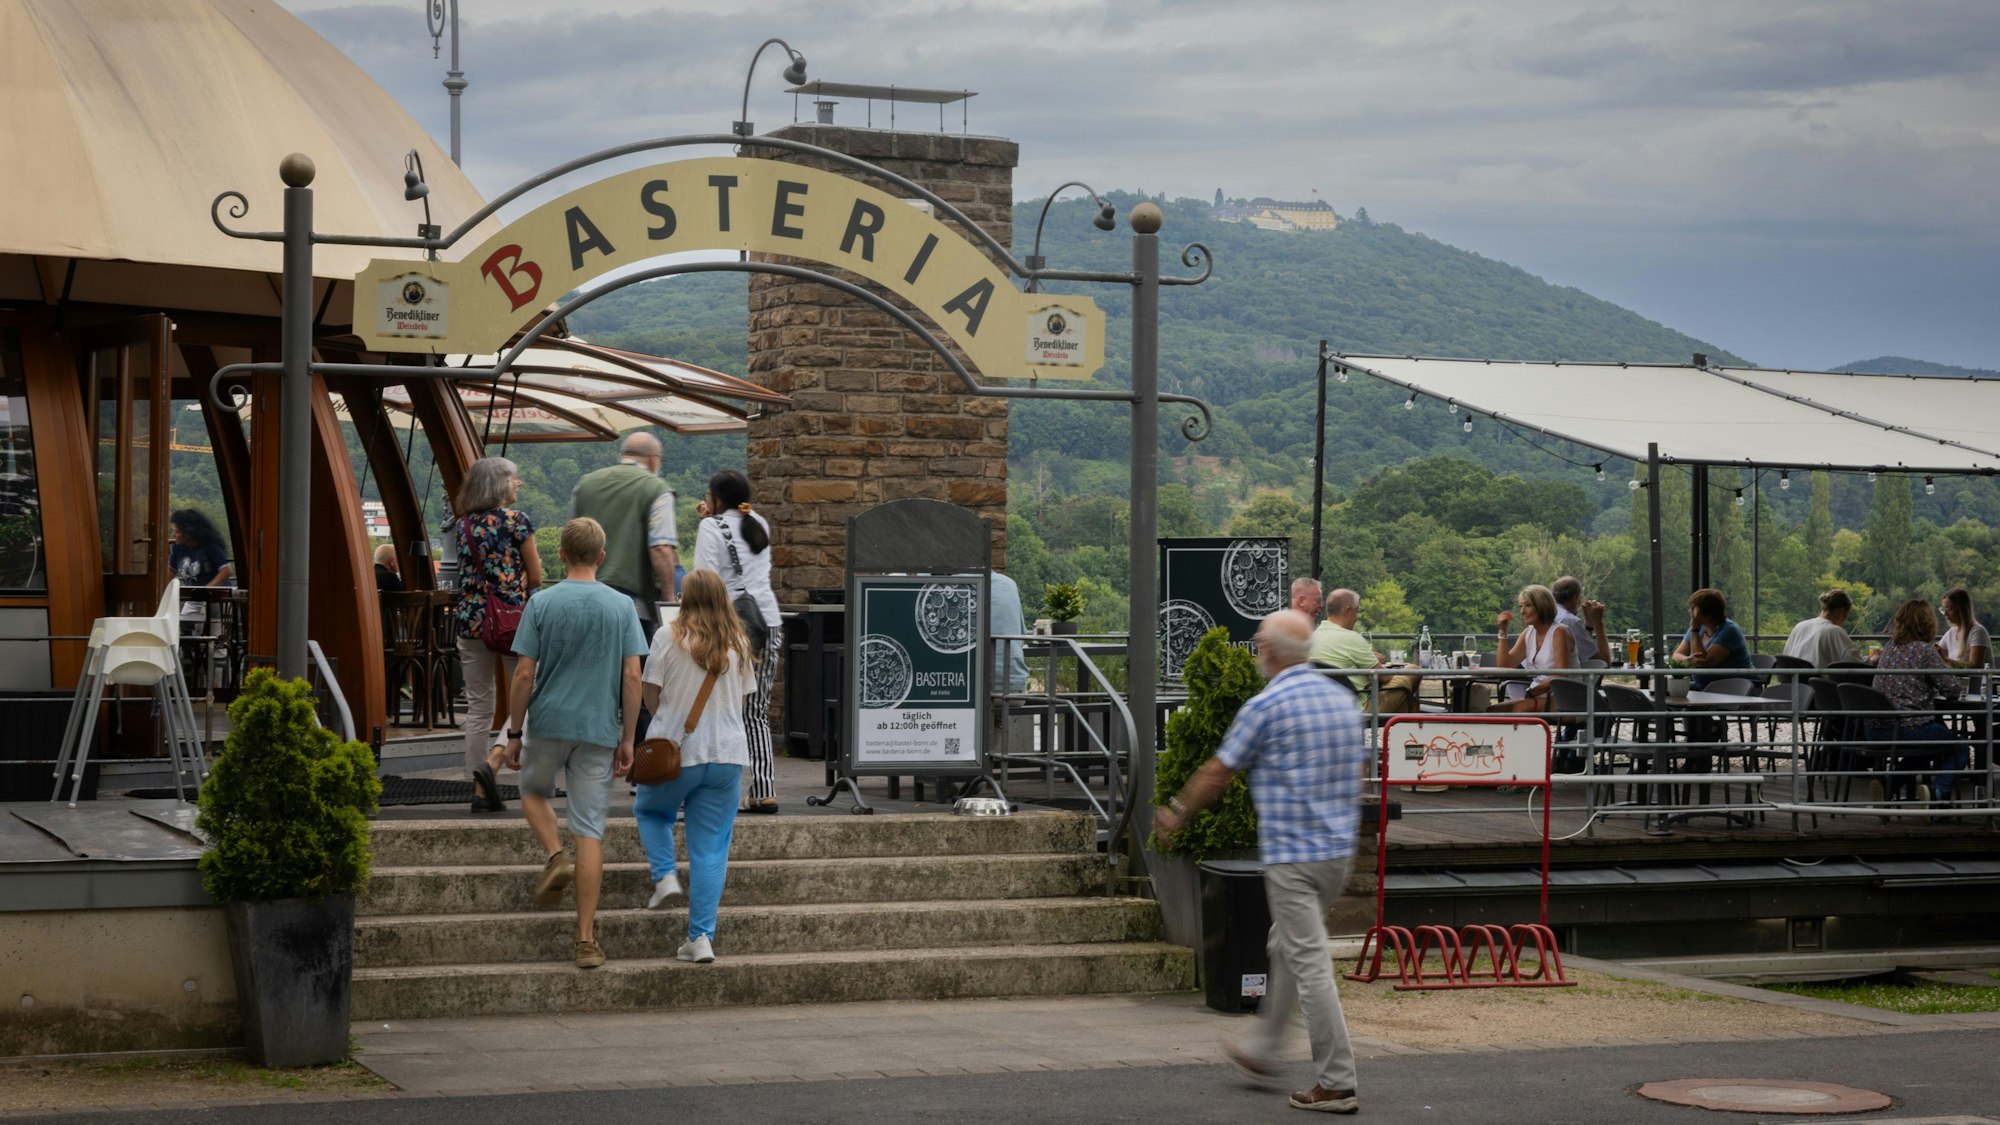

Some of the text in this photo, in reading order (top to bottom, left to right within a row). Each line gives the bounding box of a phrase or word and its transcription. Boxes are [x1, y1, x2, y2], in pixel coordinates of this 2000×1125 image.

[480, 175, 995, 338] BASTERIA
[386, 307, 440, 321] Benediktiner
[1033, 337, 1079, 351] Benediktiner
[915, 671, 966, 687] BASTERIA
[902, 712, 932, 721] täglich
[877, 721, 957, 732] ab 12:00h geöffnet
